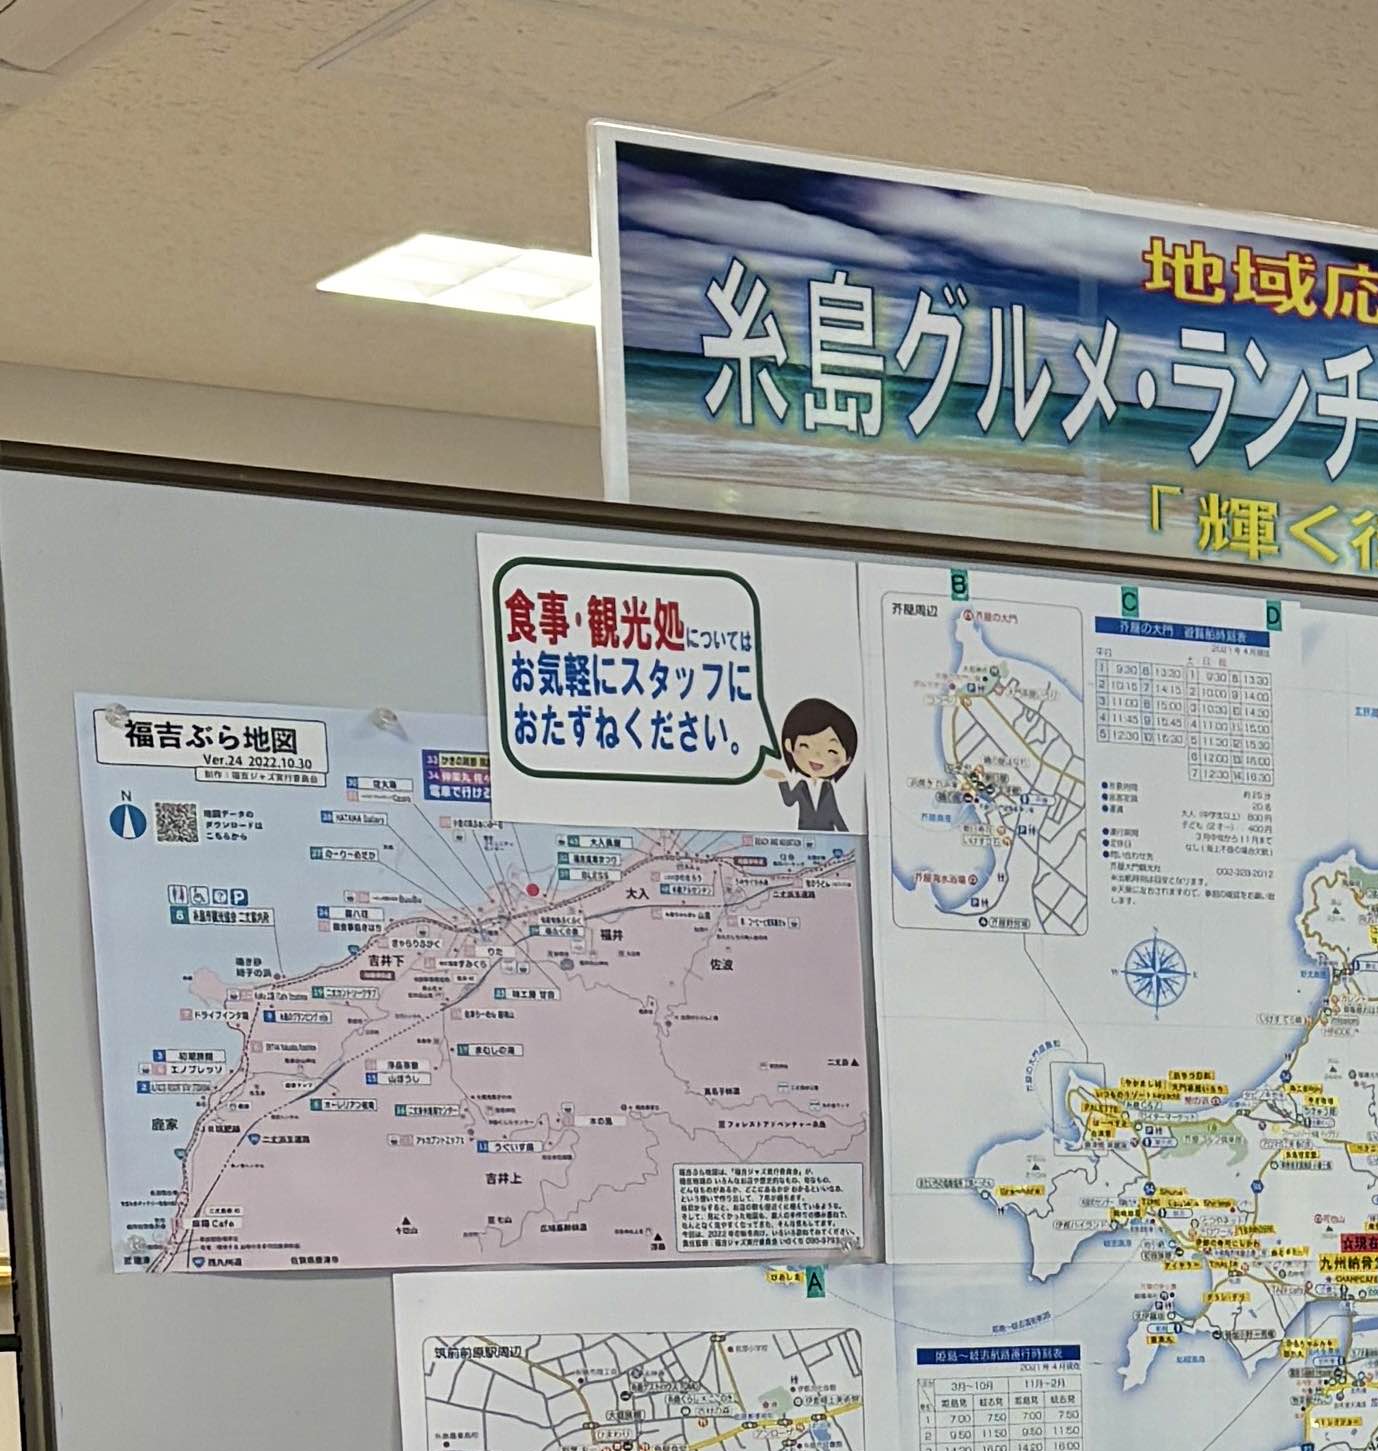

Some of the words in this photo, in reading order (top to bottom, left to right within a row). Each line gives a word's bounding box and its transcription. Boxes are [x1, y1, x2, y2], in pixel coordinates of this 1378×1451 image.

[951, 574, 966, 595] B
[1122, 590, 1137, 611] C
[504, 588, 753, 653] 食事・観光処については
[1267, 605, 1281, 625] D
[511, 650, 753, 705] お気軽にスタッフに
[125, 719, 298, 756] 福吉ぶら地図
[513, 702, 745, 757] おたずねください。
[203, 754, 243, 768] Ver.24
[248, 756, 313, 770] 2022.10.30
[625, 887, 650, 901] 大入
[600, 928, 624, 942] 福井
[368, 954, 405, 968] 吉井下
[710, 958, 735, 972] 佐波
[485, 1172, 522, 1185] 吉井上
[807, 1270, 823, 1292] A
